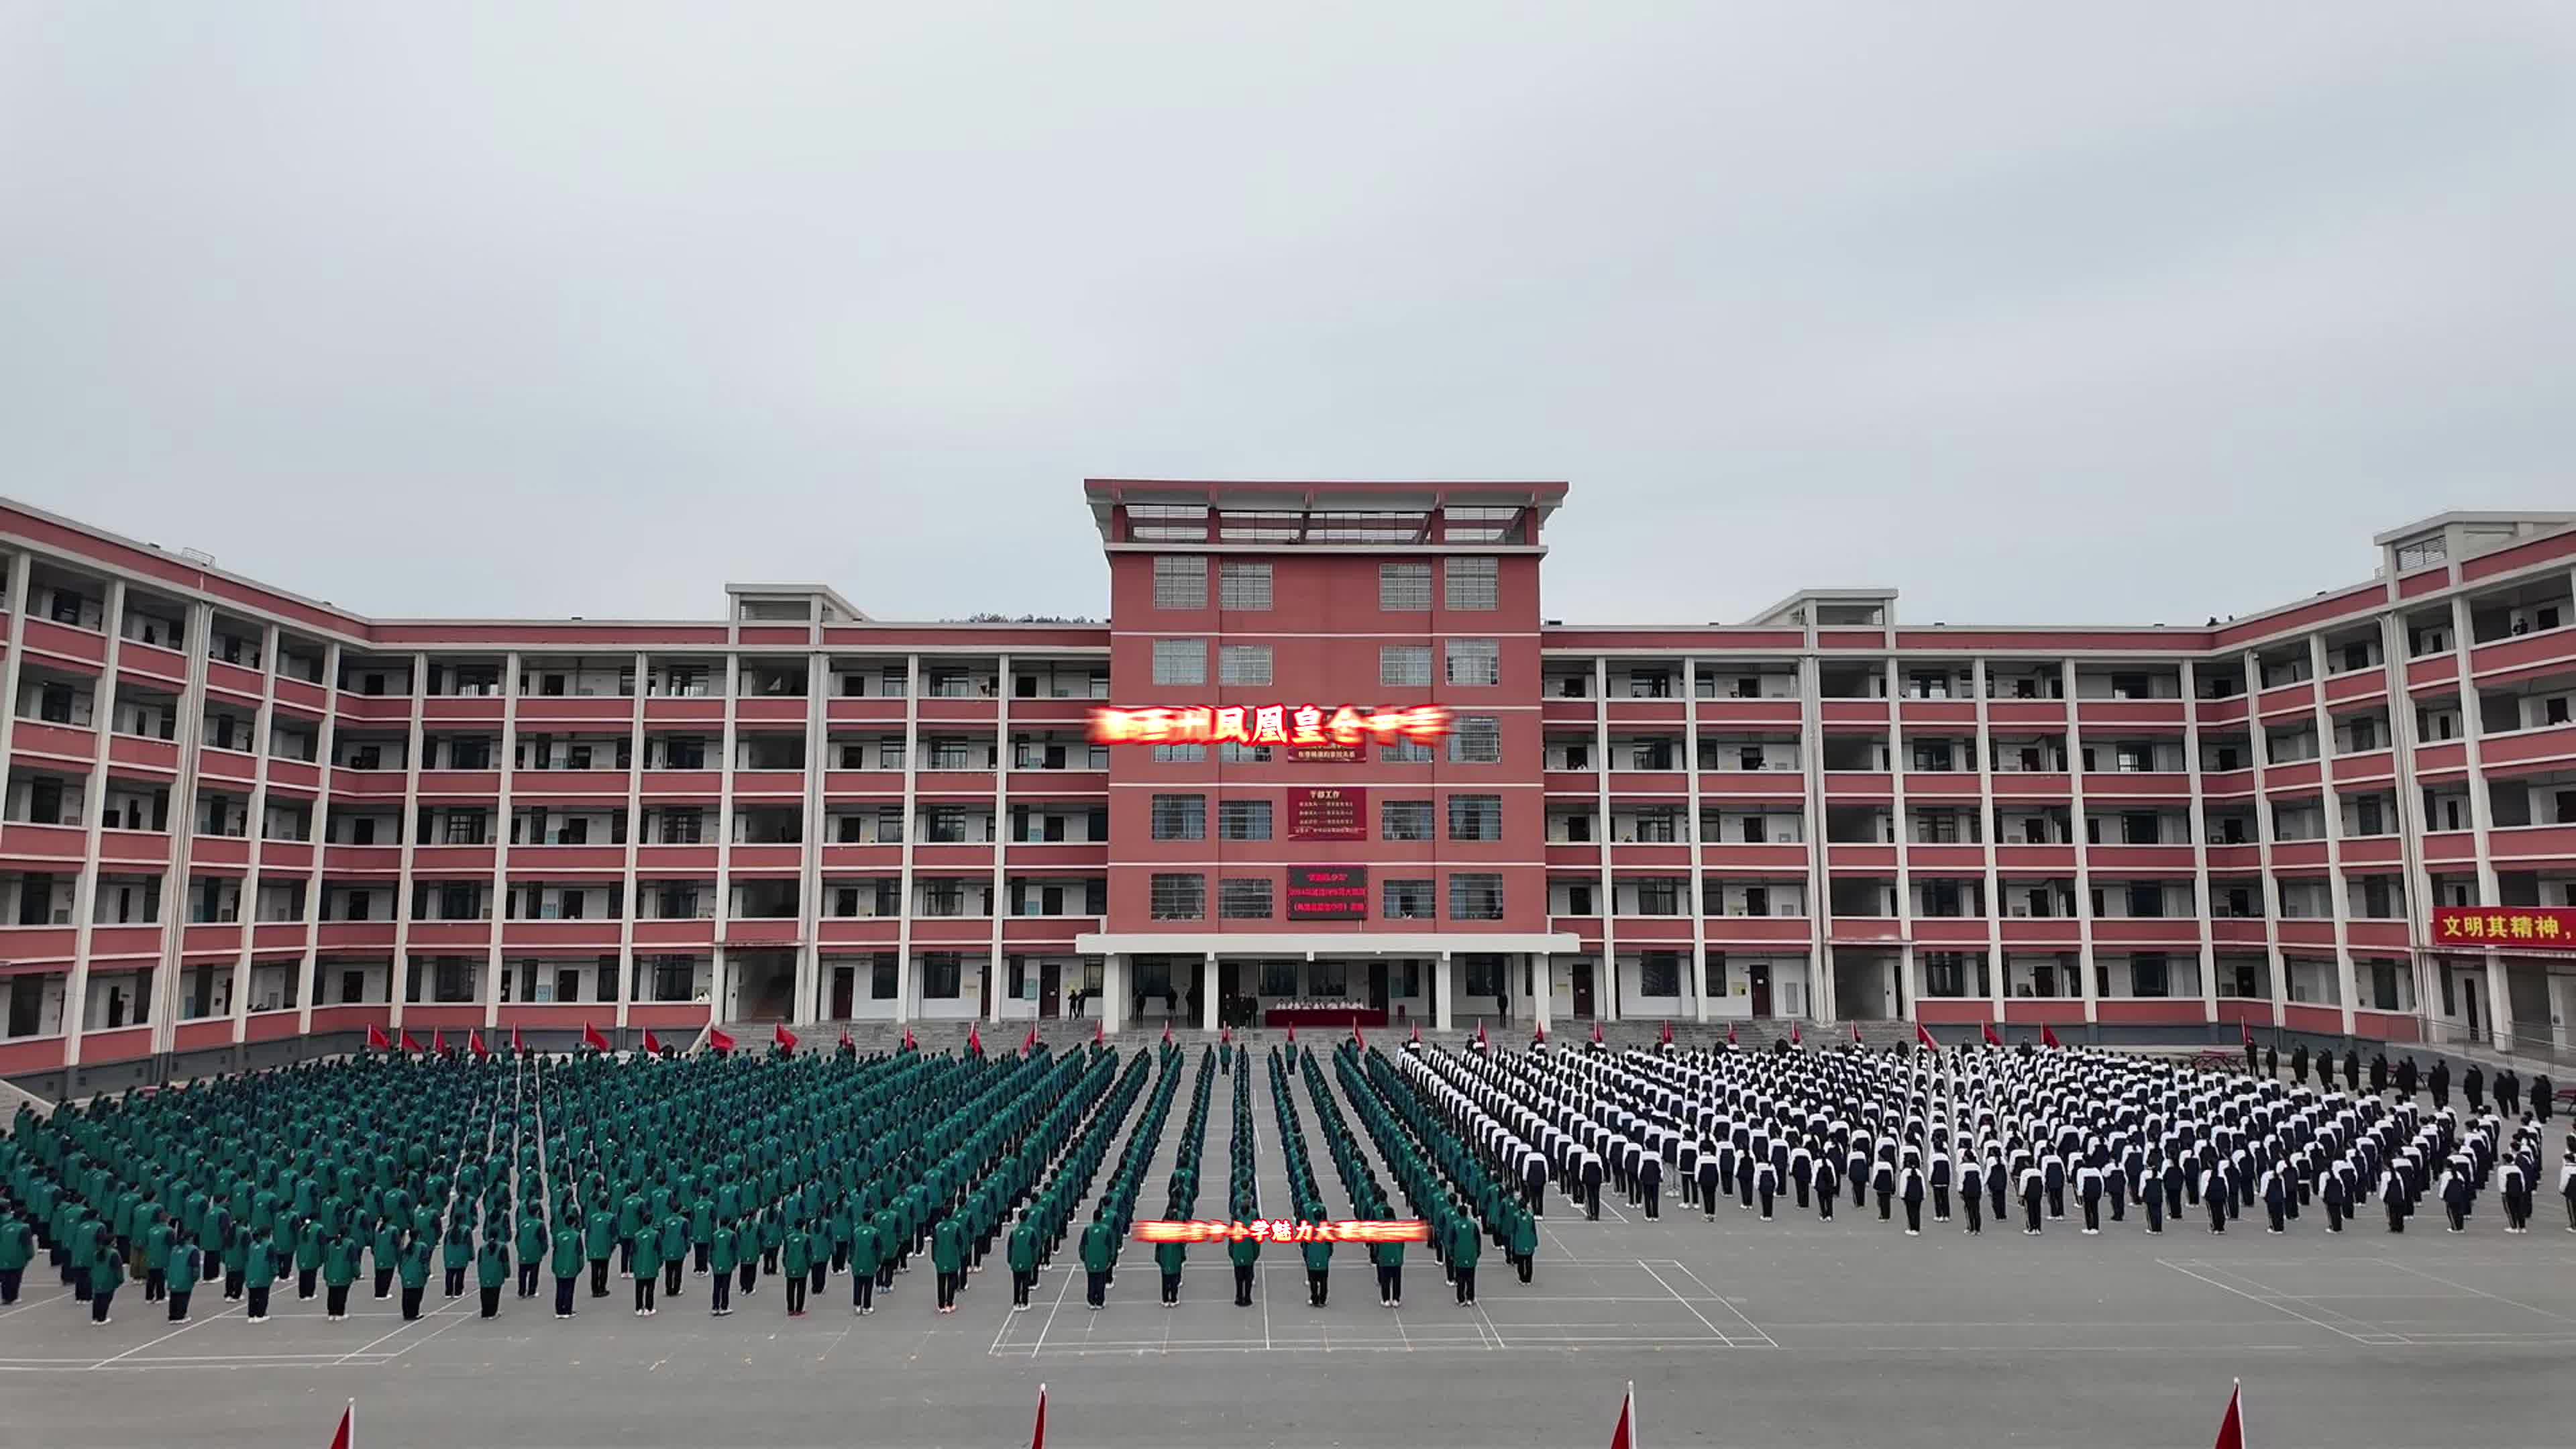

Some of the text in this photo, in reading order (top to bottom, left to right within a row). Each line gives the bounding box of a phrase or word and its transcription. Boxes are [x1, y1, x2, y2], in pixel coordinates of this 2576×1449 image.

[2442, 915, 2572, 939] 文明其精神，
